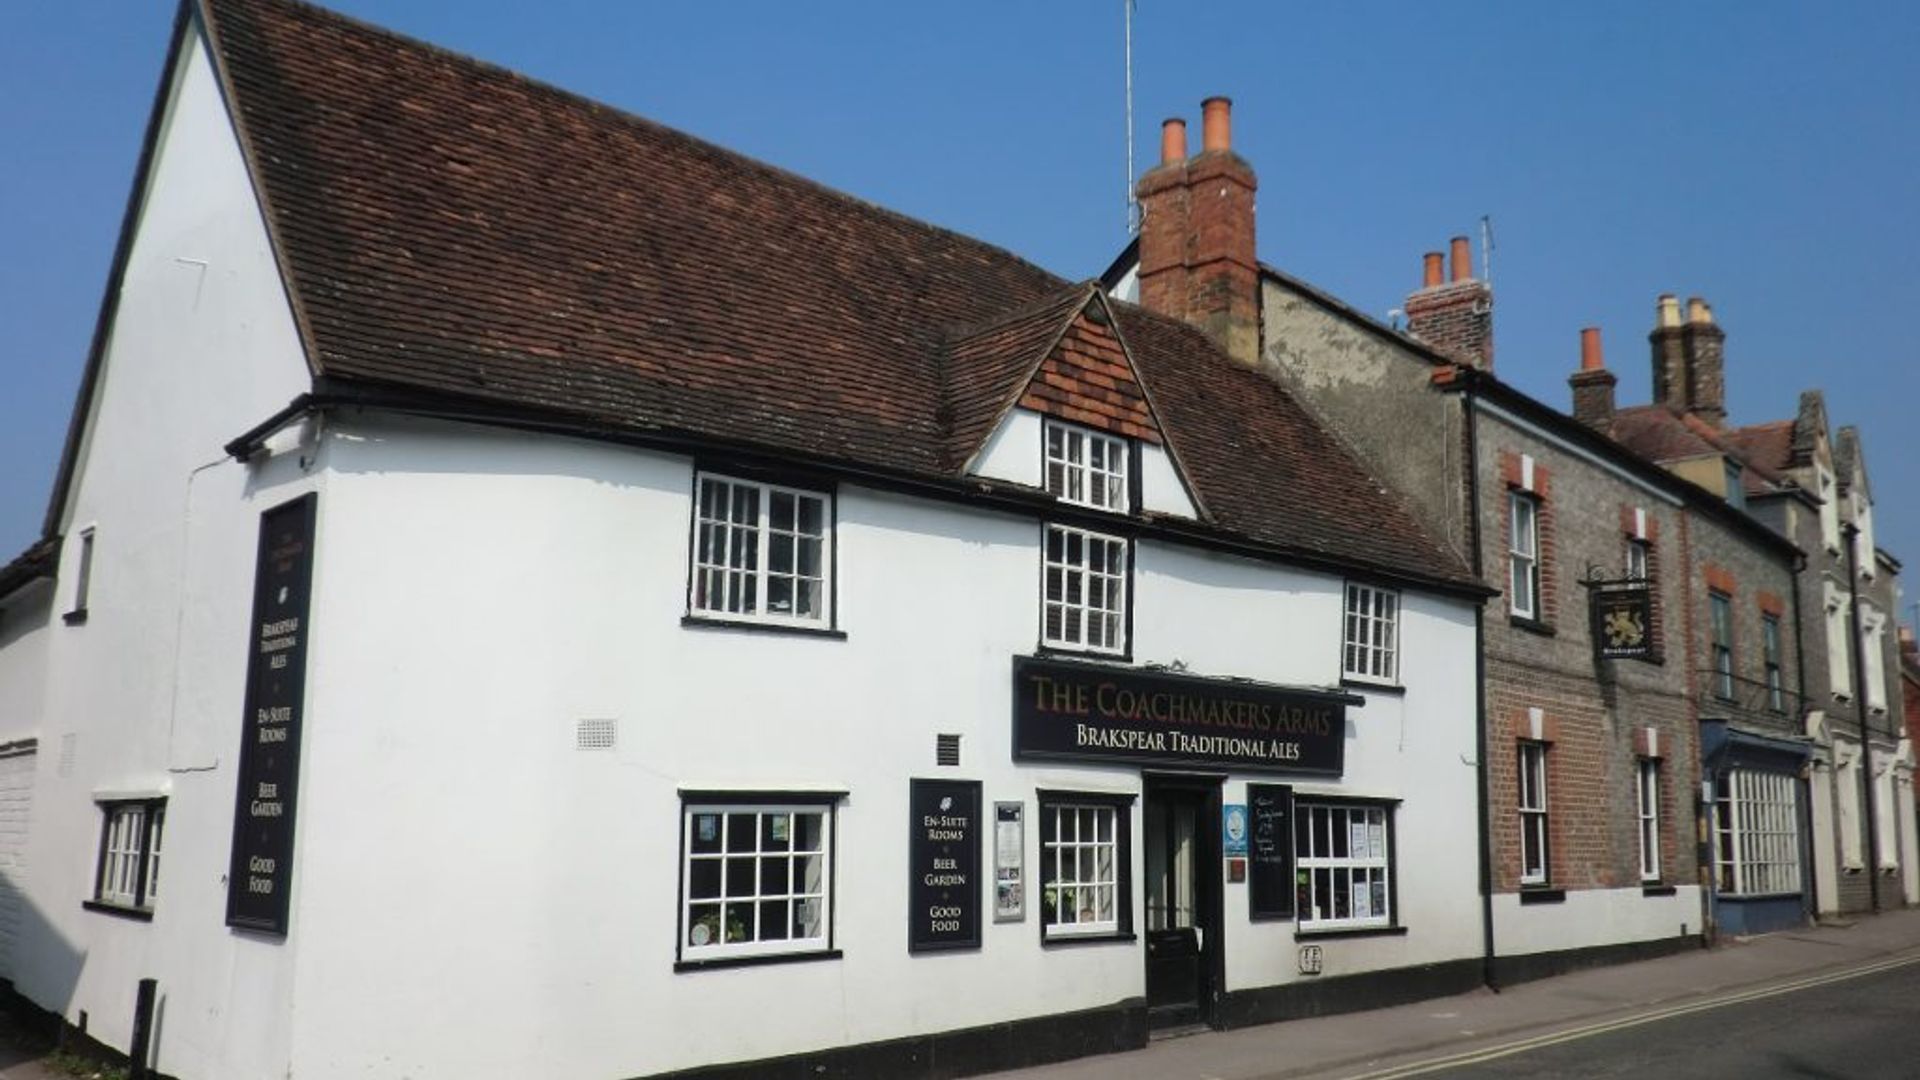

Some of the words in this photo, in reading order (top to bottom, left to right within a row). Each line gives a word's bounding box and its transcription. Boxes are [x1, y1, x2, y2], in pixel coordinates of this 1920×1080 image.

[1030, 675, 1090, 715] THE
[1097, 681, 1271, 732] COACHMAKERS
[1276, 705, 1332, 736] ARMS
[259, 727, 287, 744] ROOMS
[1077, 723, 1167, 751] BRAKSPEAR
[1169, 730, 1267, 758] TRADITIONAL
[1269, 738, 1300, 760] ALES
[258, 782, 277, 798] BEER
[251, 799, 283, 817] GARDEN
[924, 815, 968, 828] EN-SUITE
[928, 829, 963, 841] ROOMS
[249, 855, 275, 874] GOOD
[933, 858, 957, 870] BEER
[249, 875, 273, 894] FOOD
[924, 873, 966, 886] GARDEN
[929, 905, 961, 918] GOOD
[931, 920, 960, 932] FOOD
